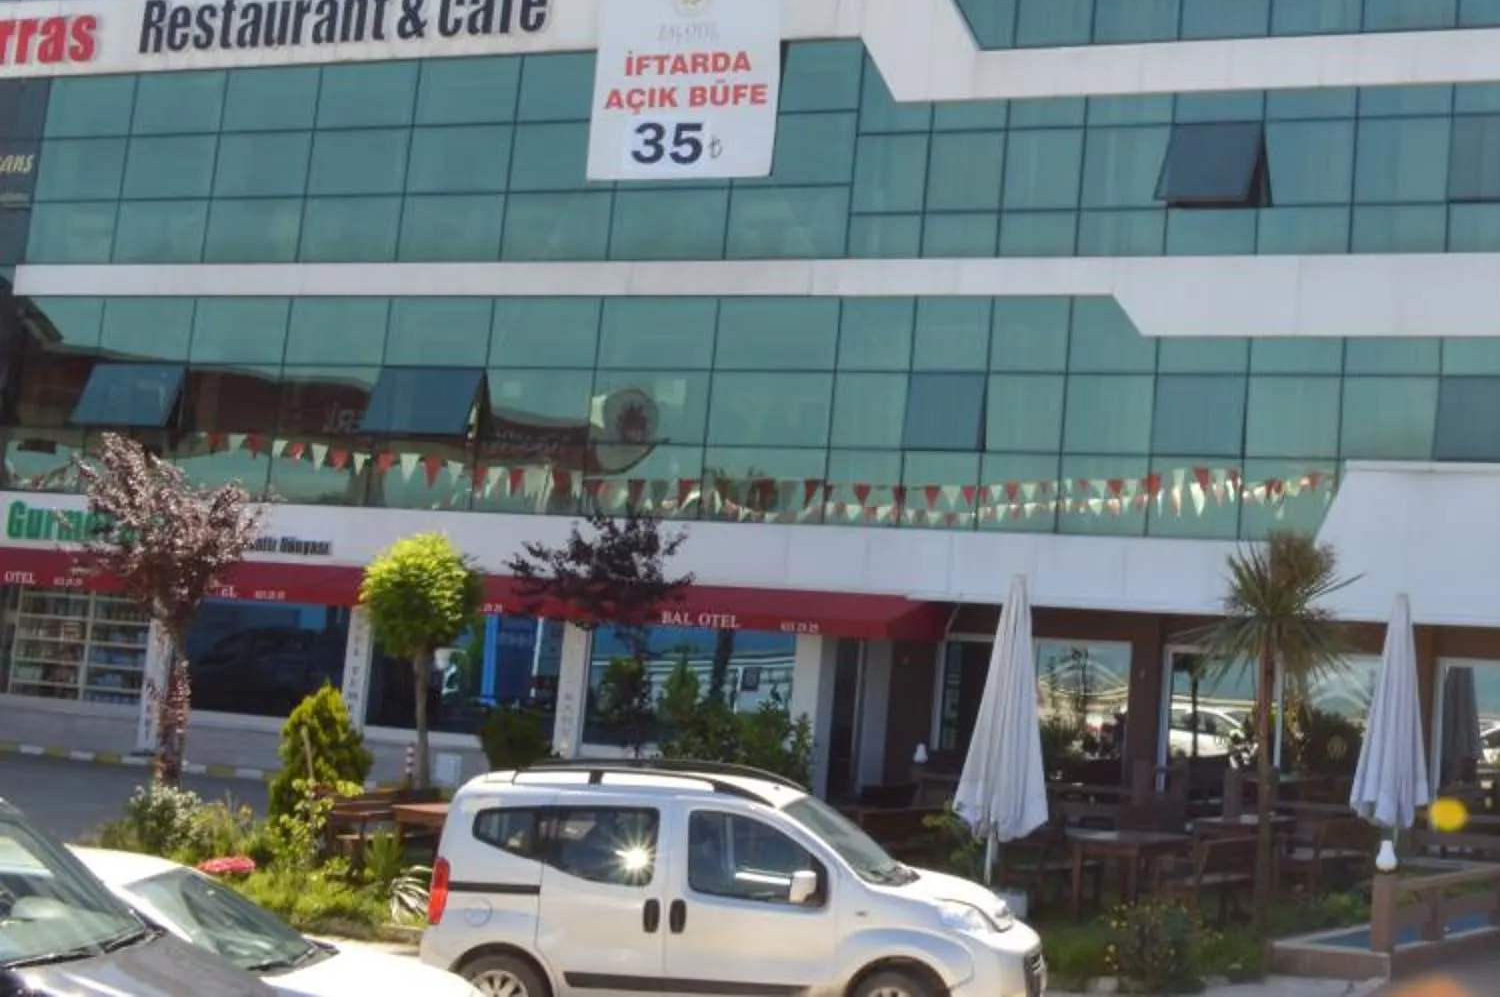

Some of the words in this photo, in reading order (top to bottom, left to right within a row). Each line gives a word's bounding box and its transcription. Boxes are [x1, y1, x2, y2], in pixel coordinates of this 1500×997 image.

[624, 50, 752, 77] İFTARDA
[604, 86, 678, 115] AÇIK
[689, 78, 769, 107] BÜFE
[661, 610, 693, 626] BAL
[698, 612, 741, 628] OTEL
